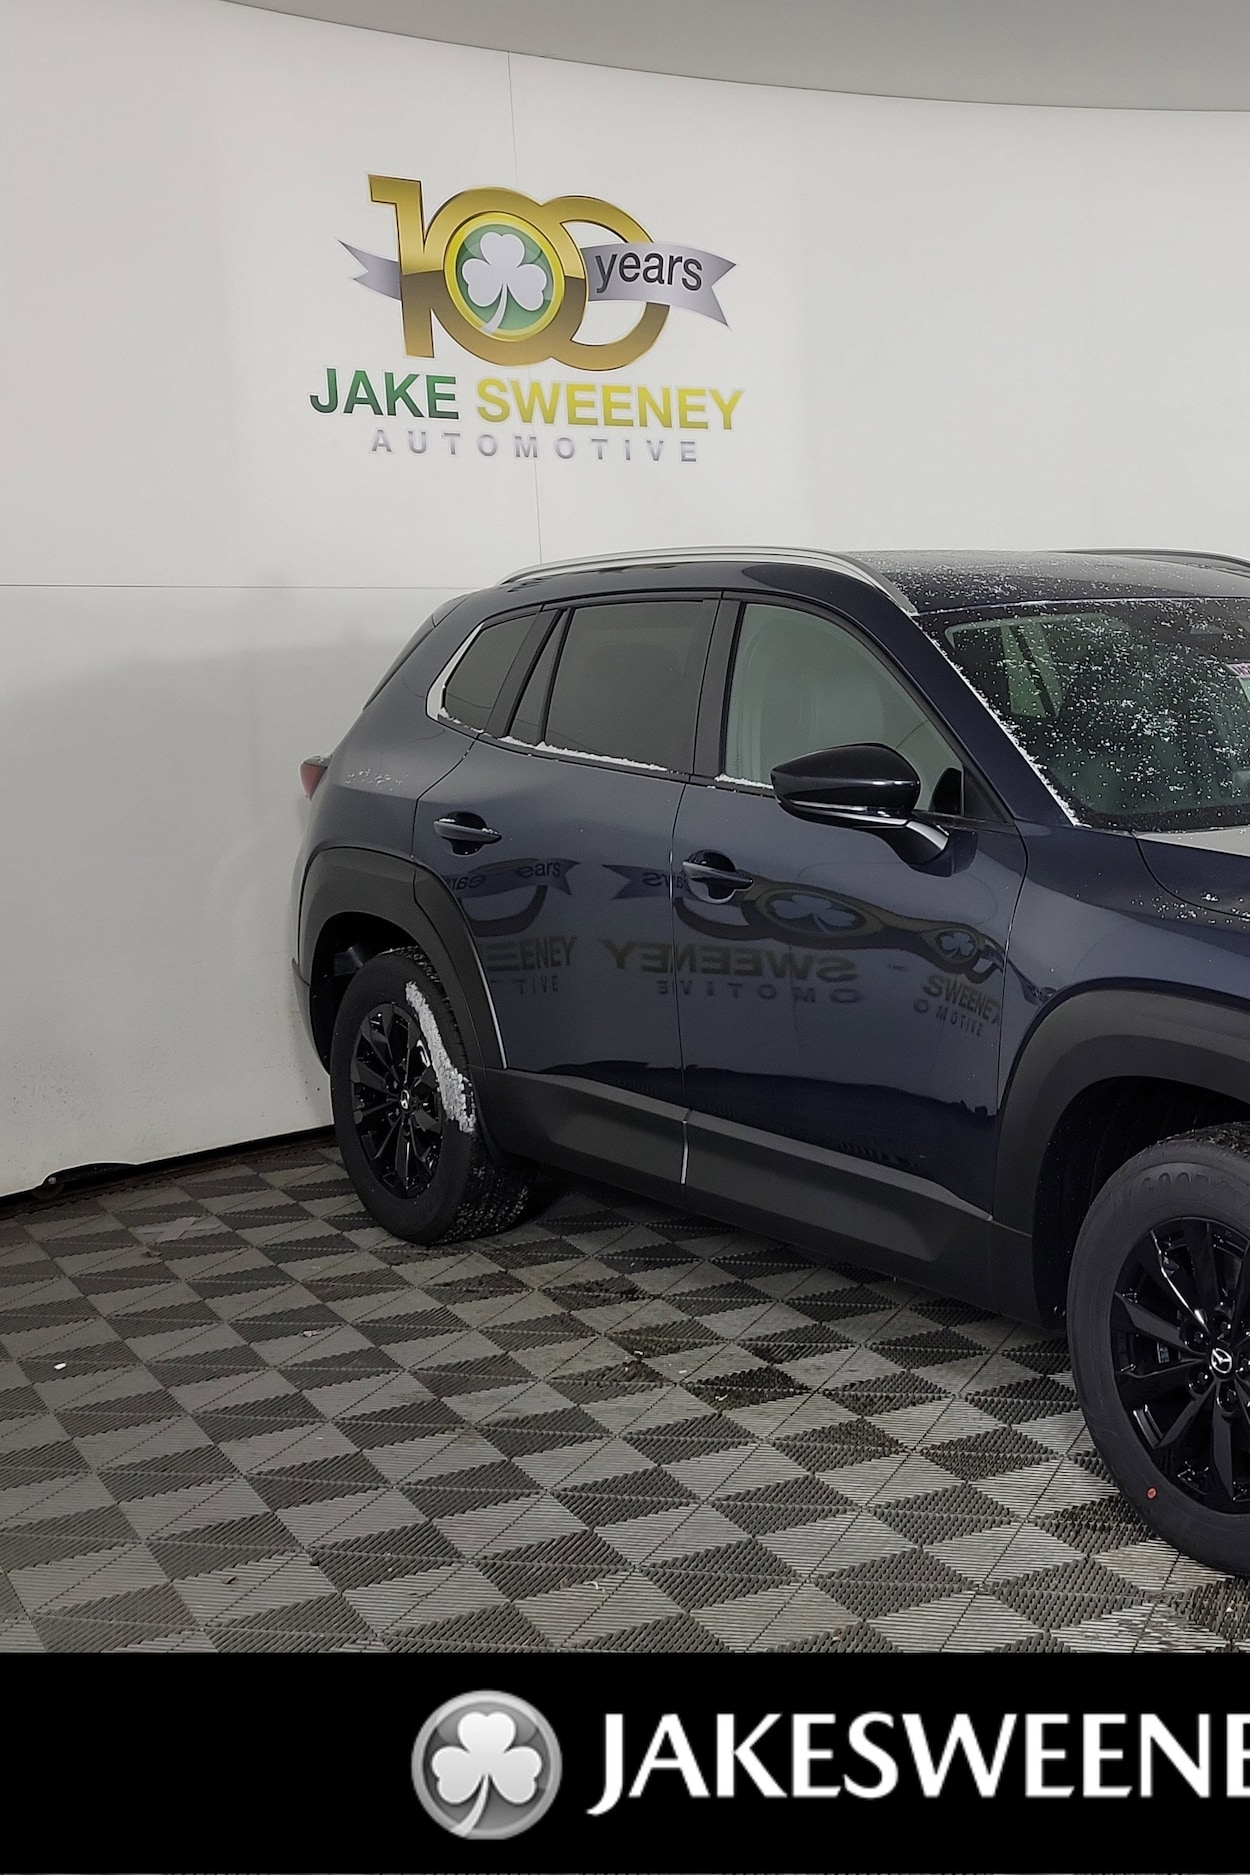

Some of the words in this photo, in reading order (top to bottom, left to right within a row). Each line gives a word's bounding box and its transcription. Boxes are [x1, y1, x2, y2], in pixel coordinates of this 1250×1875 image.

[367, 173, 670, 371] 100
[595, 251, 703, 293] years
[309, 368, 459, 420] JAKE
[476, 377, 744, 430] SWEENEY
[371, 429, 697, 462] AUTOMOTIVE
